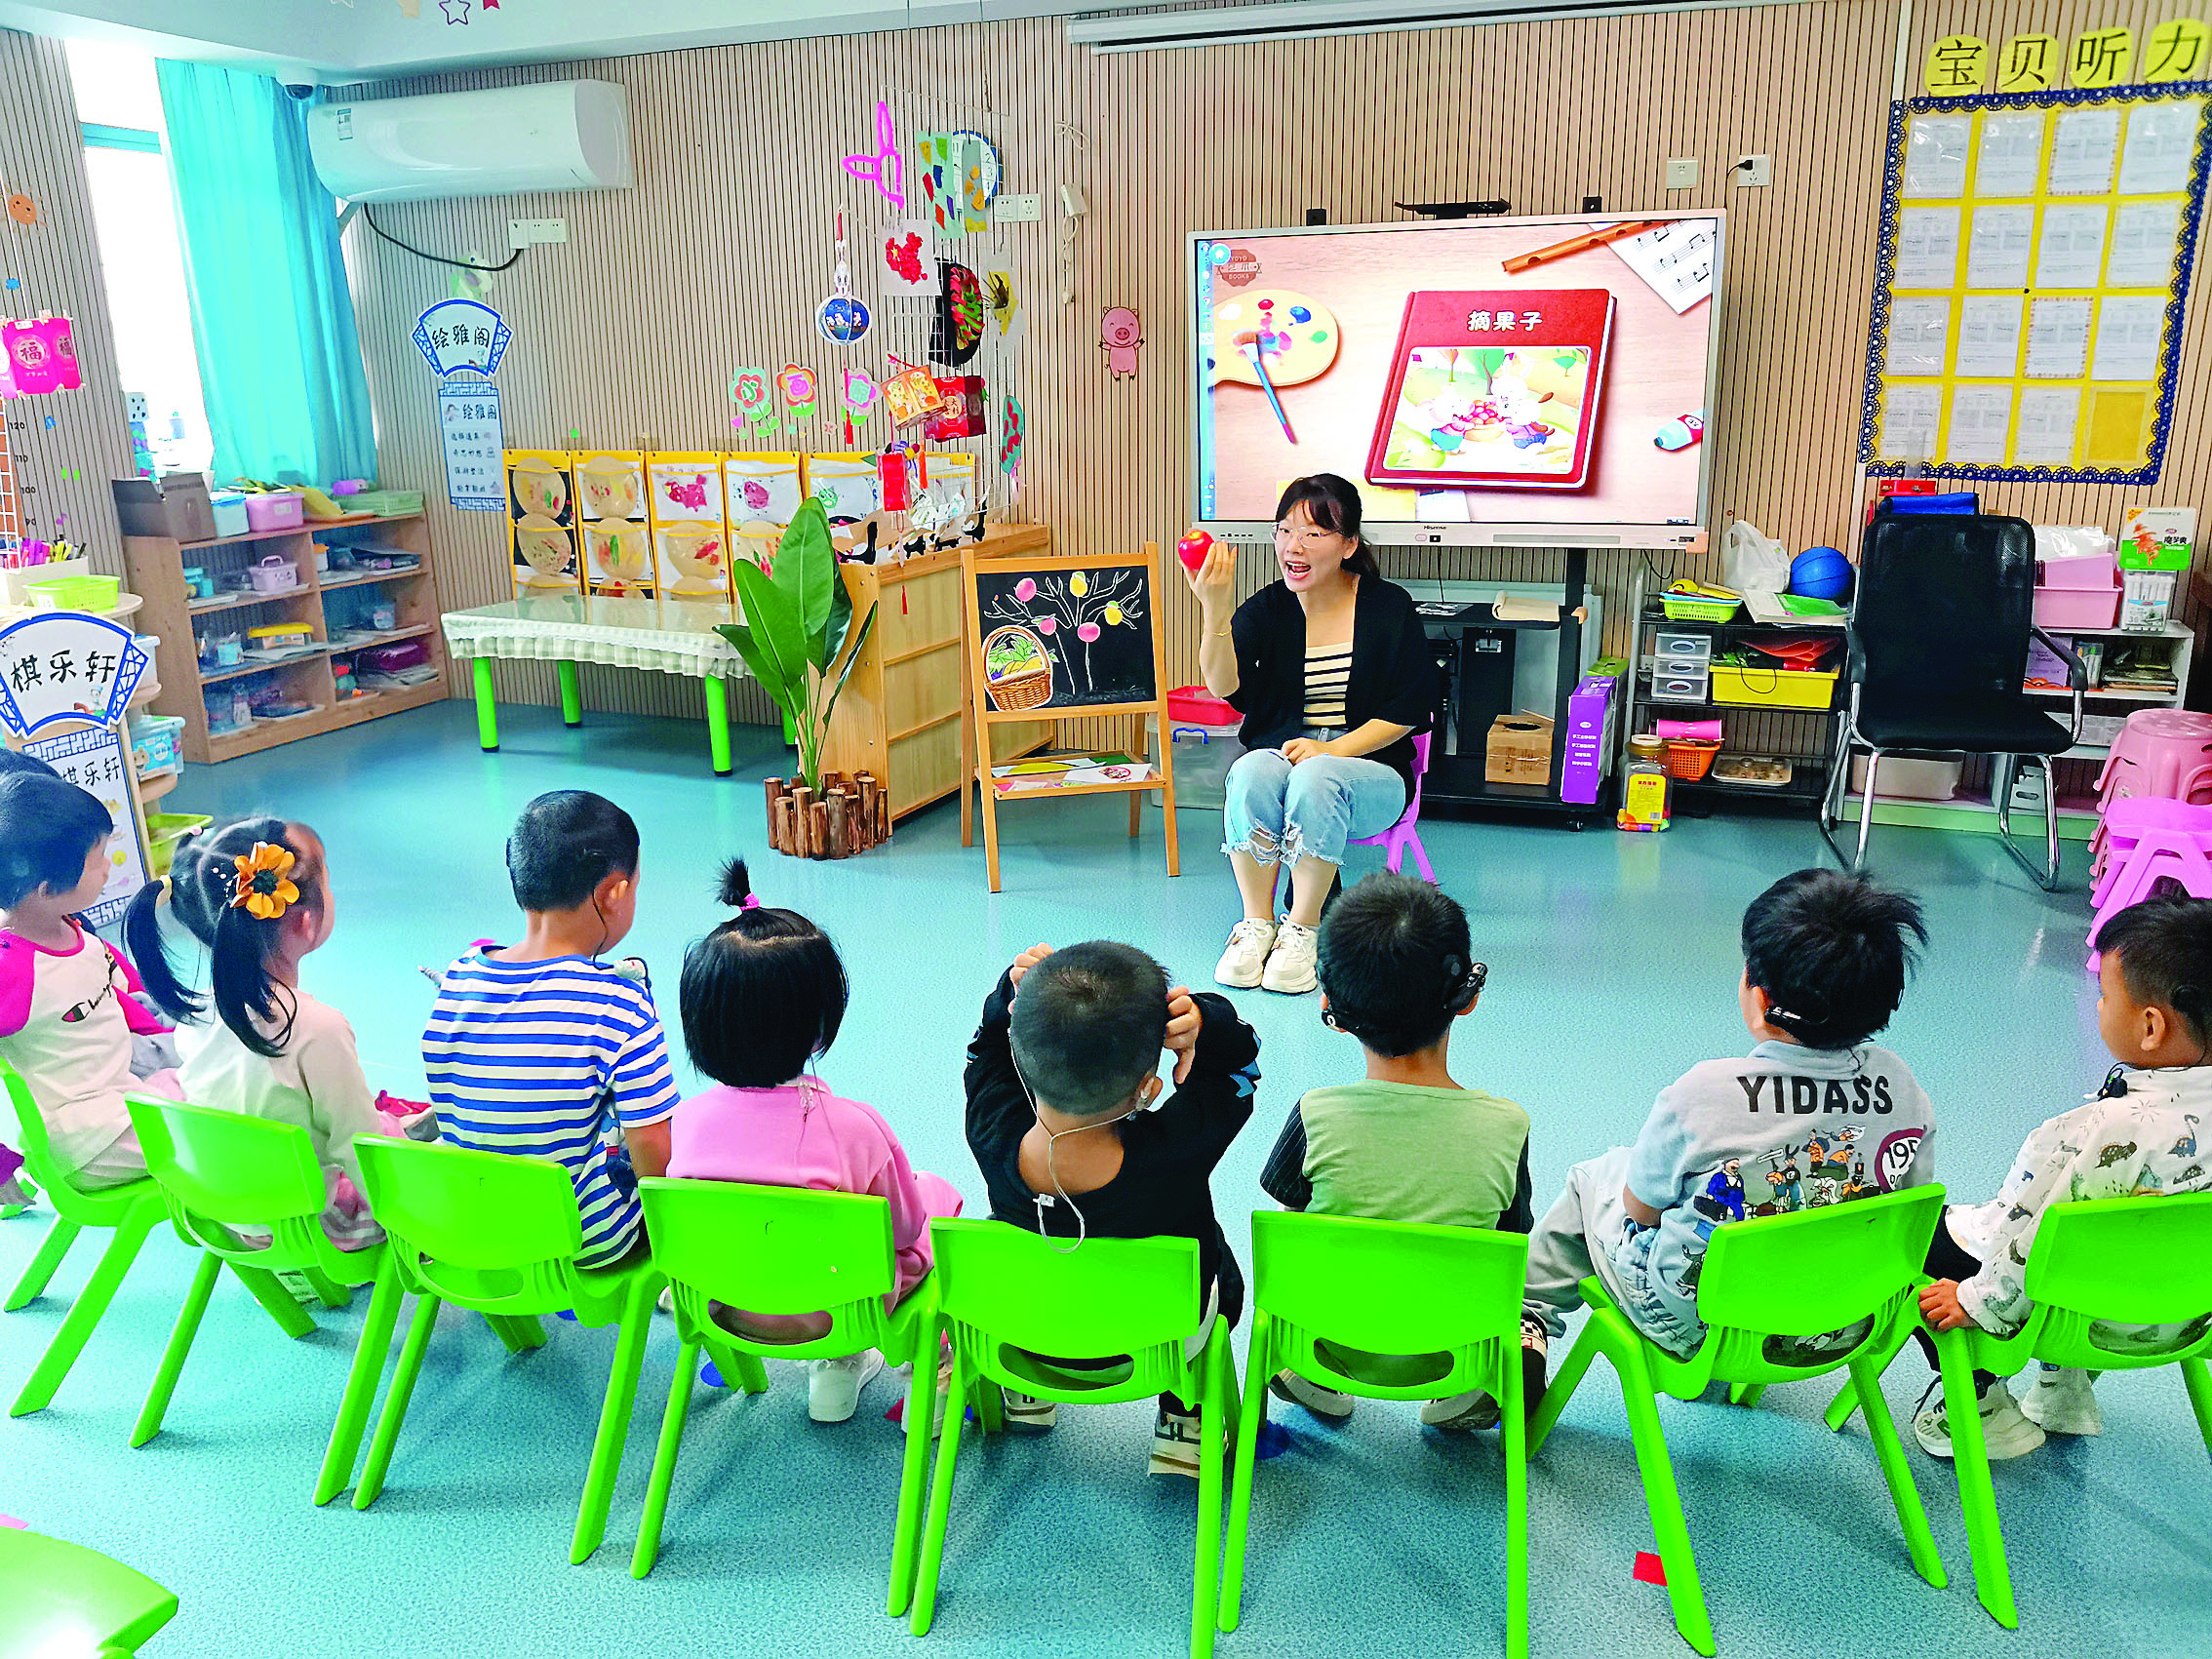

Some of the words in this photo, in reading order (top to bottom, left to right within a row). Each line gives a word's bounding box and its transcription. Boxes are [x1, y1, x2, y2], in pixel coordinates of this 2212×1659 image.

[1930, 24, 2202, 87] 宝贝听力
[1467, 310, 1543, 332] 摘果子
[432, 324, 490, 350] 绘雅阁
[20, 341, 42, 361] 福
[462, 403, 497, 420] 绘雅阁
[15, 454, 28, 463] 110
[25, 518, 37, 527] 90
[10, 649, 117, 693] 棋乐轩
[1735, 1074, 1893, 1115] YIDASS
